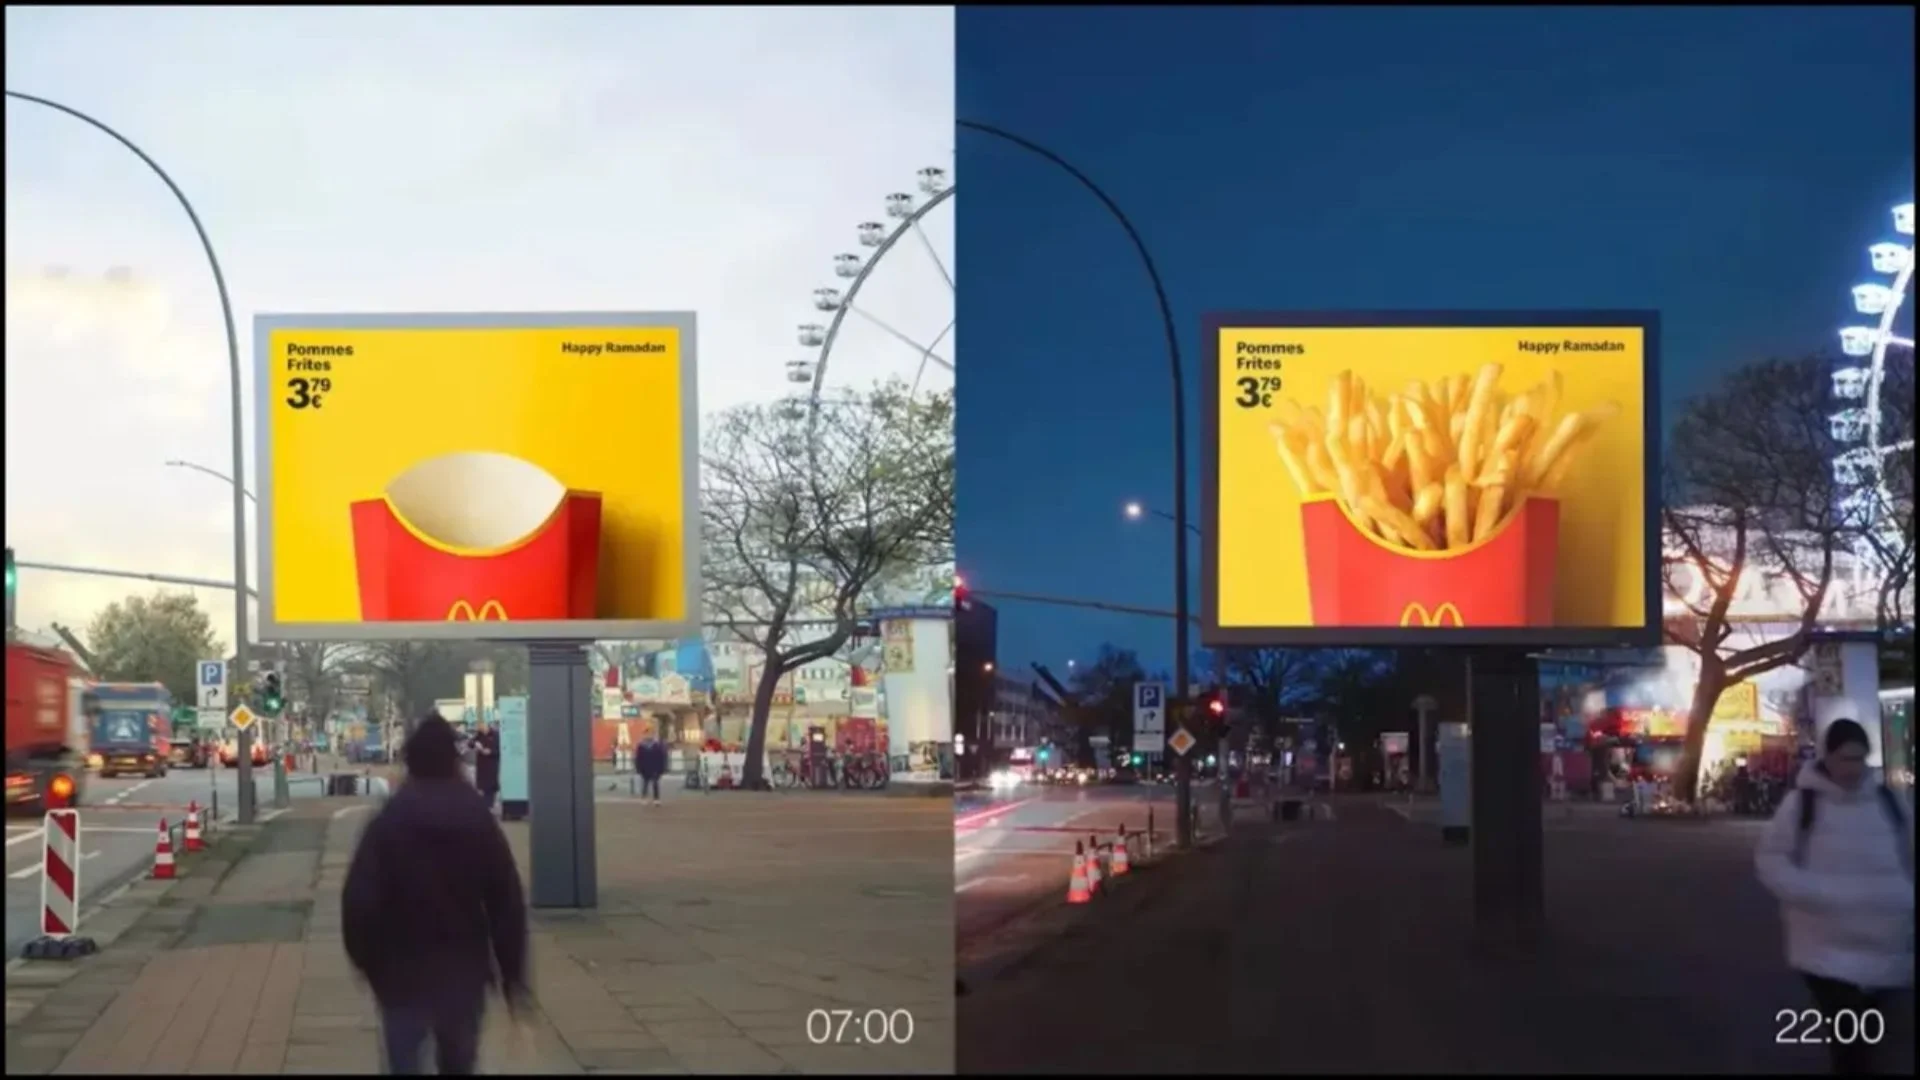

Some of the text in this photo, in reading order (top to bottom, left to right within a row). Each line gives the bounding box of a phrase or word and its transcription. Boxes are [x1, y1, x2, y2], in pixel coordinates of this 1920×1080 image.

[287, 342, 354, 356] Pommes
[561, 341, 667, 359] Happy Ramadan
[1236, 341, 1305, 355] Pommes
[1518, 338, 1626, 358] Happy Ramadan
[287, 358, 332, 371] Frites
[1236, 356, 1282, 370] Frites
[205, 664, 218, 683] P
[1143, 688, 1155, 706] P
